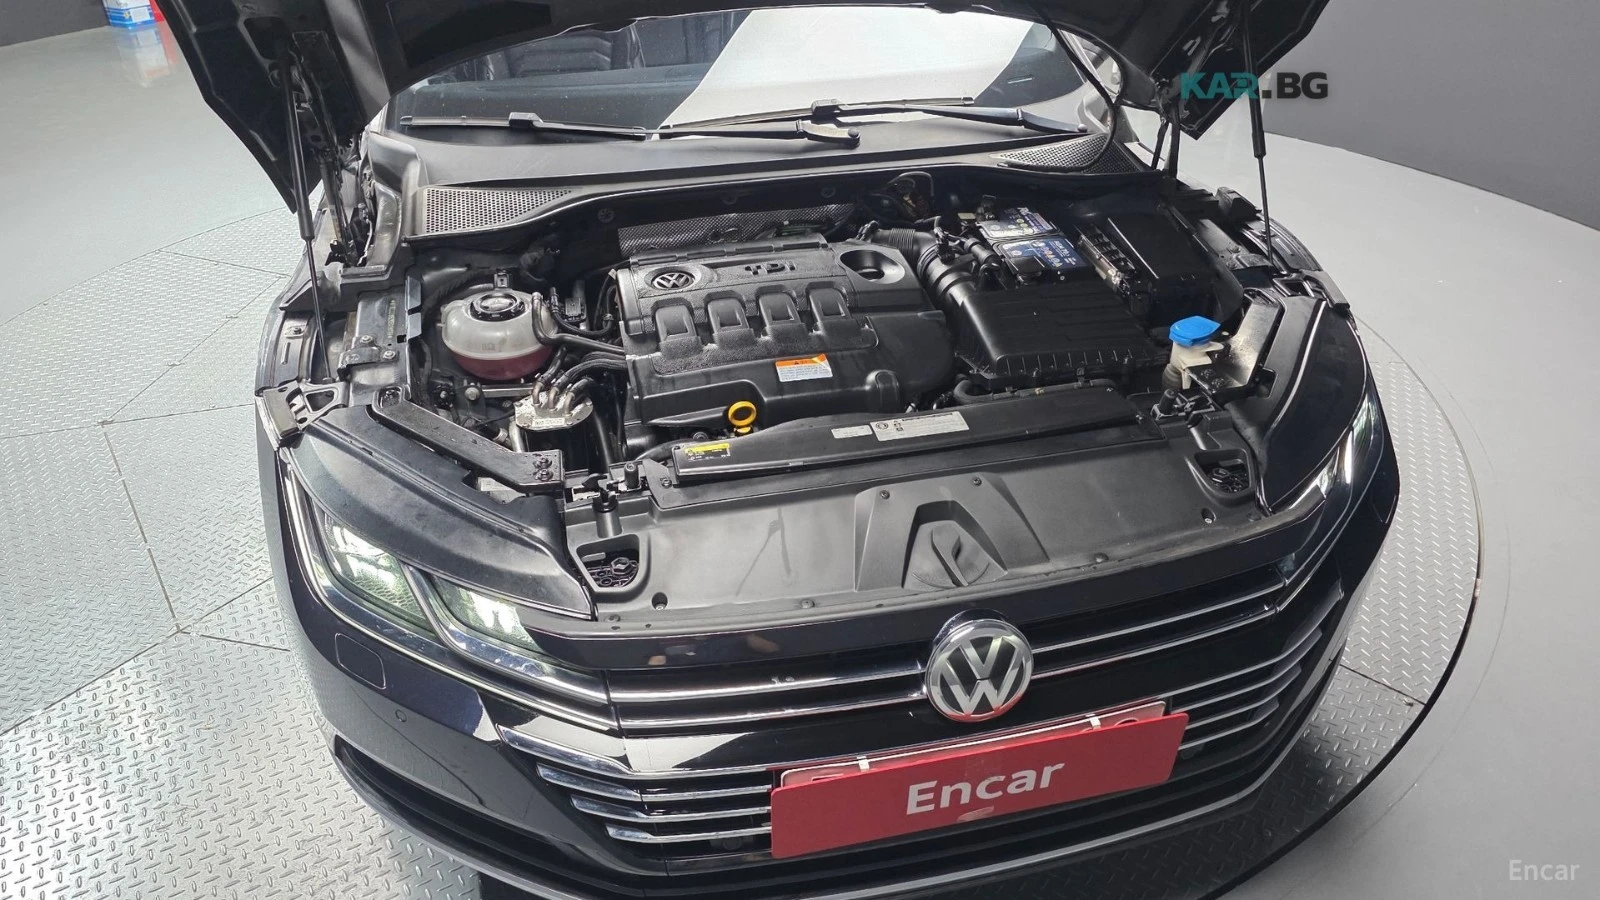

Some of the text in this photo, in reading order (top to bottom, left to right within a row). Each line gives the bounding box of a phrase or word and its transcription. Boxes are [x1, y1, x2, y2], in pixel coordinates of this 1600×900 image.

[653, 272, 694, 290] VW
[744, 260, 797, 276] TDI
[931, 625, 1030, 719] VW
[906, 762, 1065, 815] Encar
